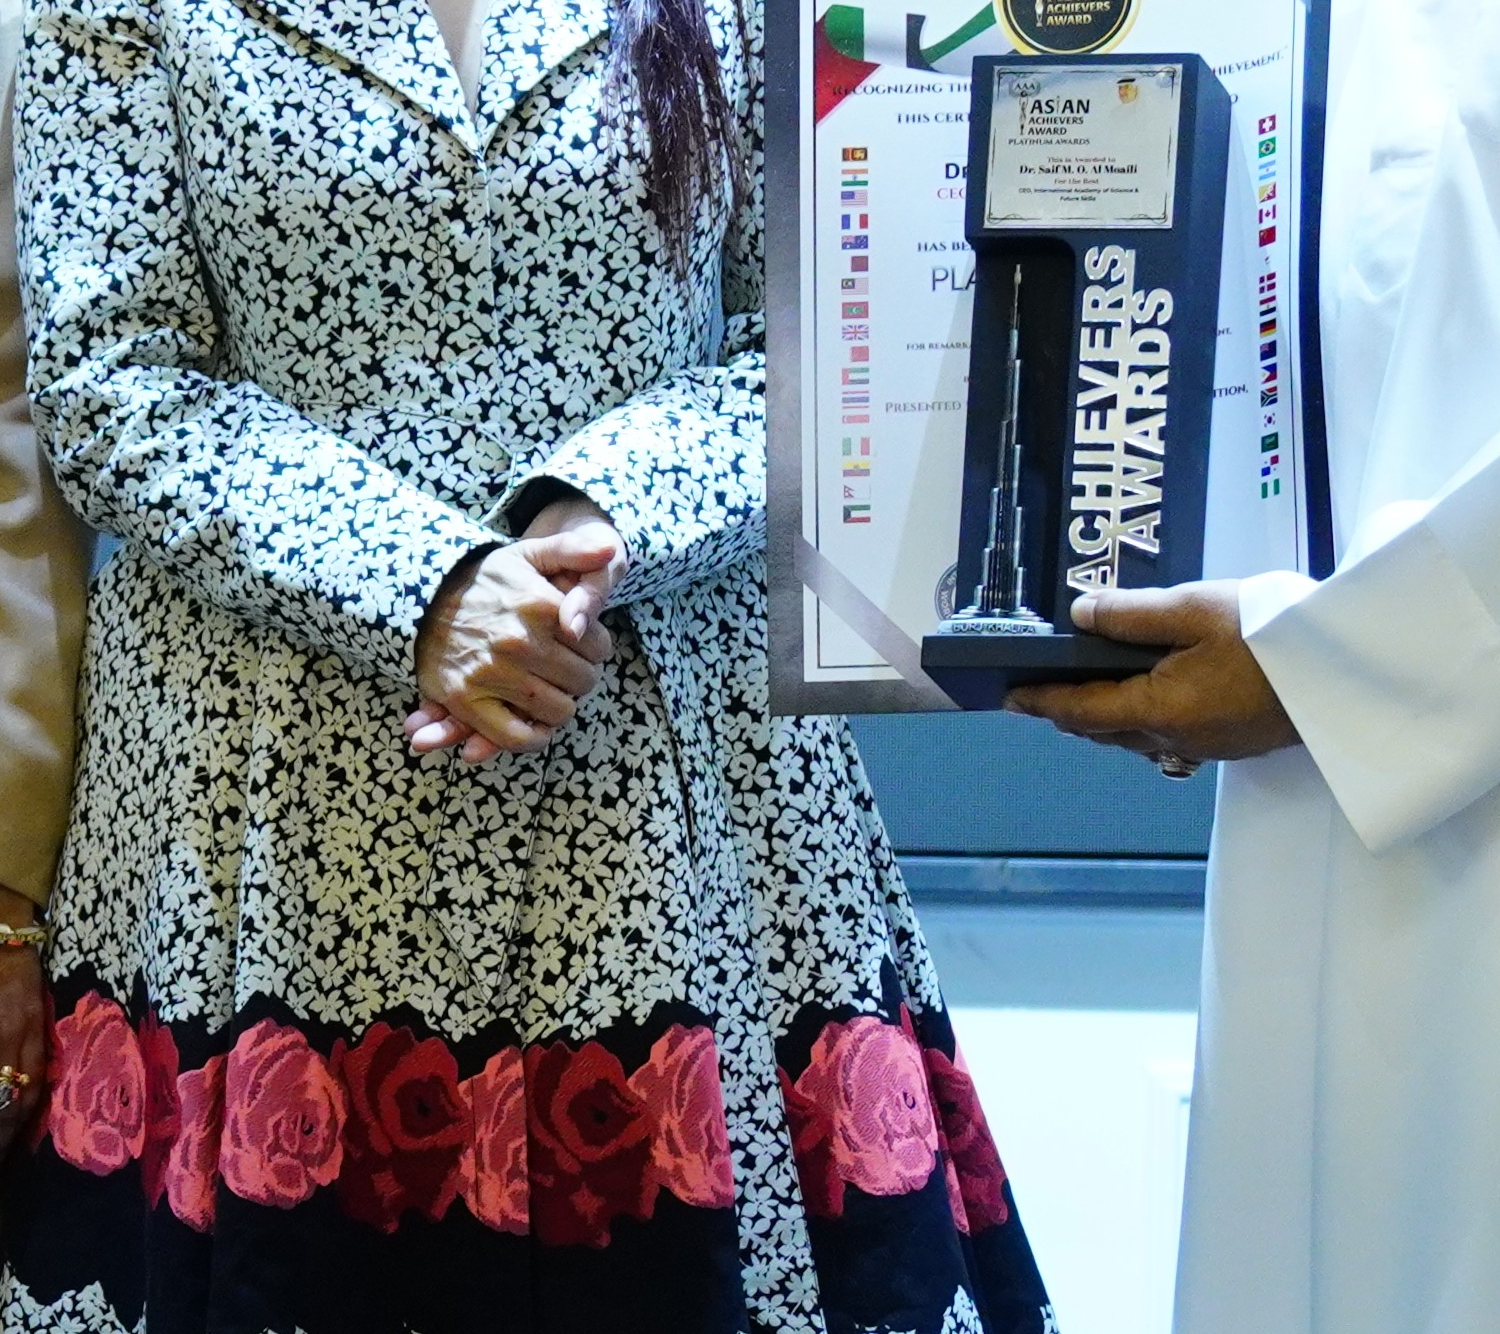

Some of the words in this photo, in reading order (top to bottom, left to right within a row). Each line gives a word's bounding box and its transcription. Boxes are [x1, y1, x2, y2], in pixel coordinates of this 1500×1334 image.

[1046, 1, 1111, 14] ACHIEVERS
[1046, 14, 1092, 26] AWARD
[897, 113, 930, 124] THIS
[1028, 116, 1084, 125] ACHIEVERS
[1027, 127, 1067, 136] AWARD
[1008, 138, 1053, 146] PLATINUM
[1055, 138, 1091, 146] AWARDS
[917, 241, 947, 252] HAS
[885, 400, 962, 413] PRESENTED
[1066, 244, 1129, 593] ACHIEVERS
[1118, 287, 1173, 555] AWARDS
